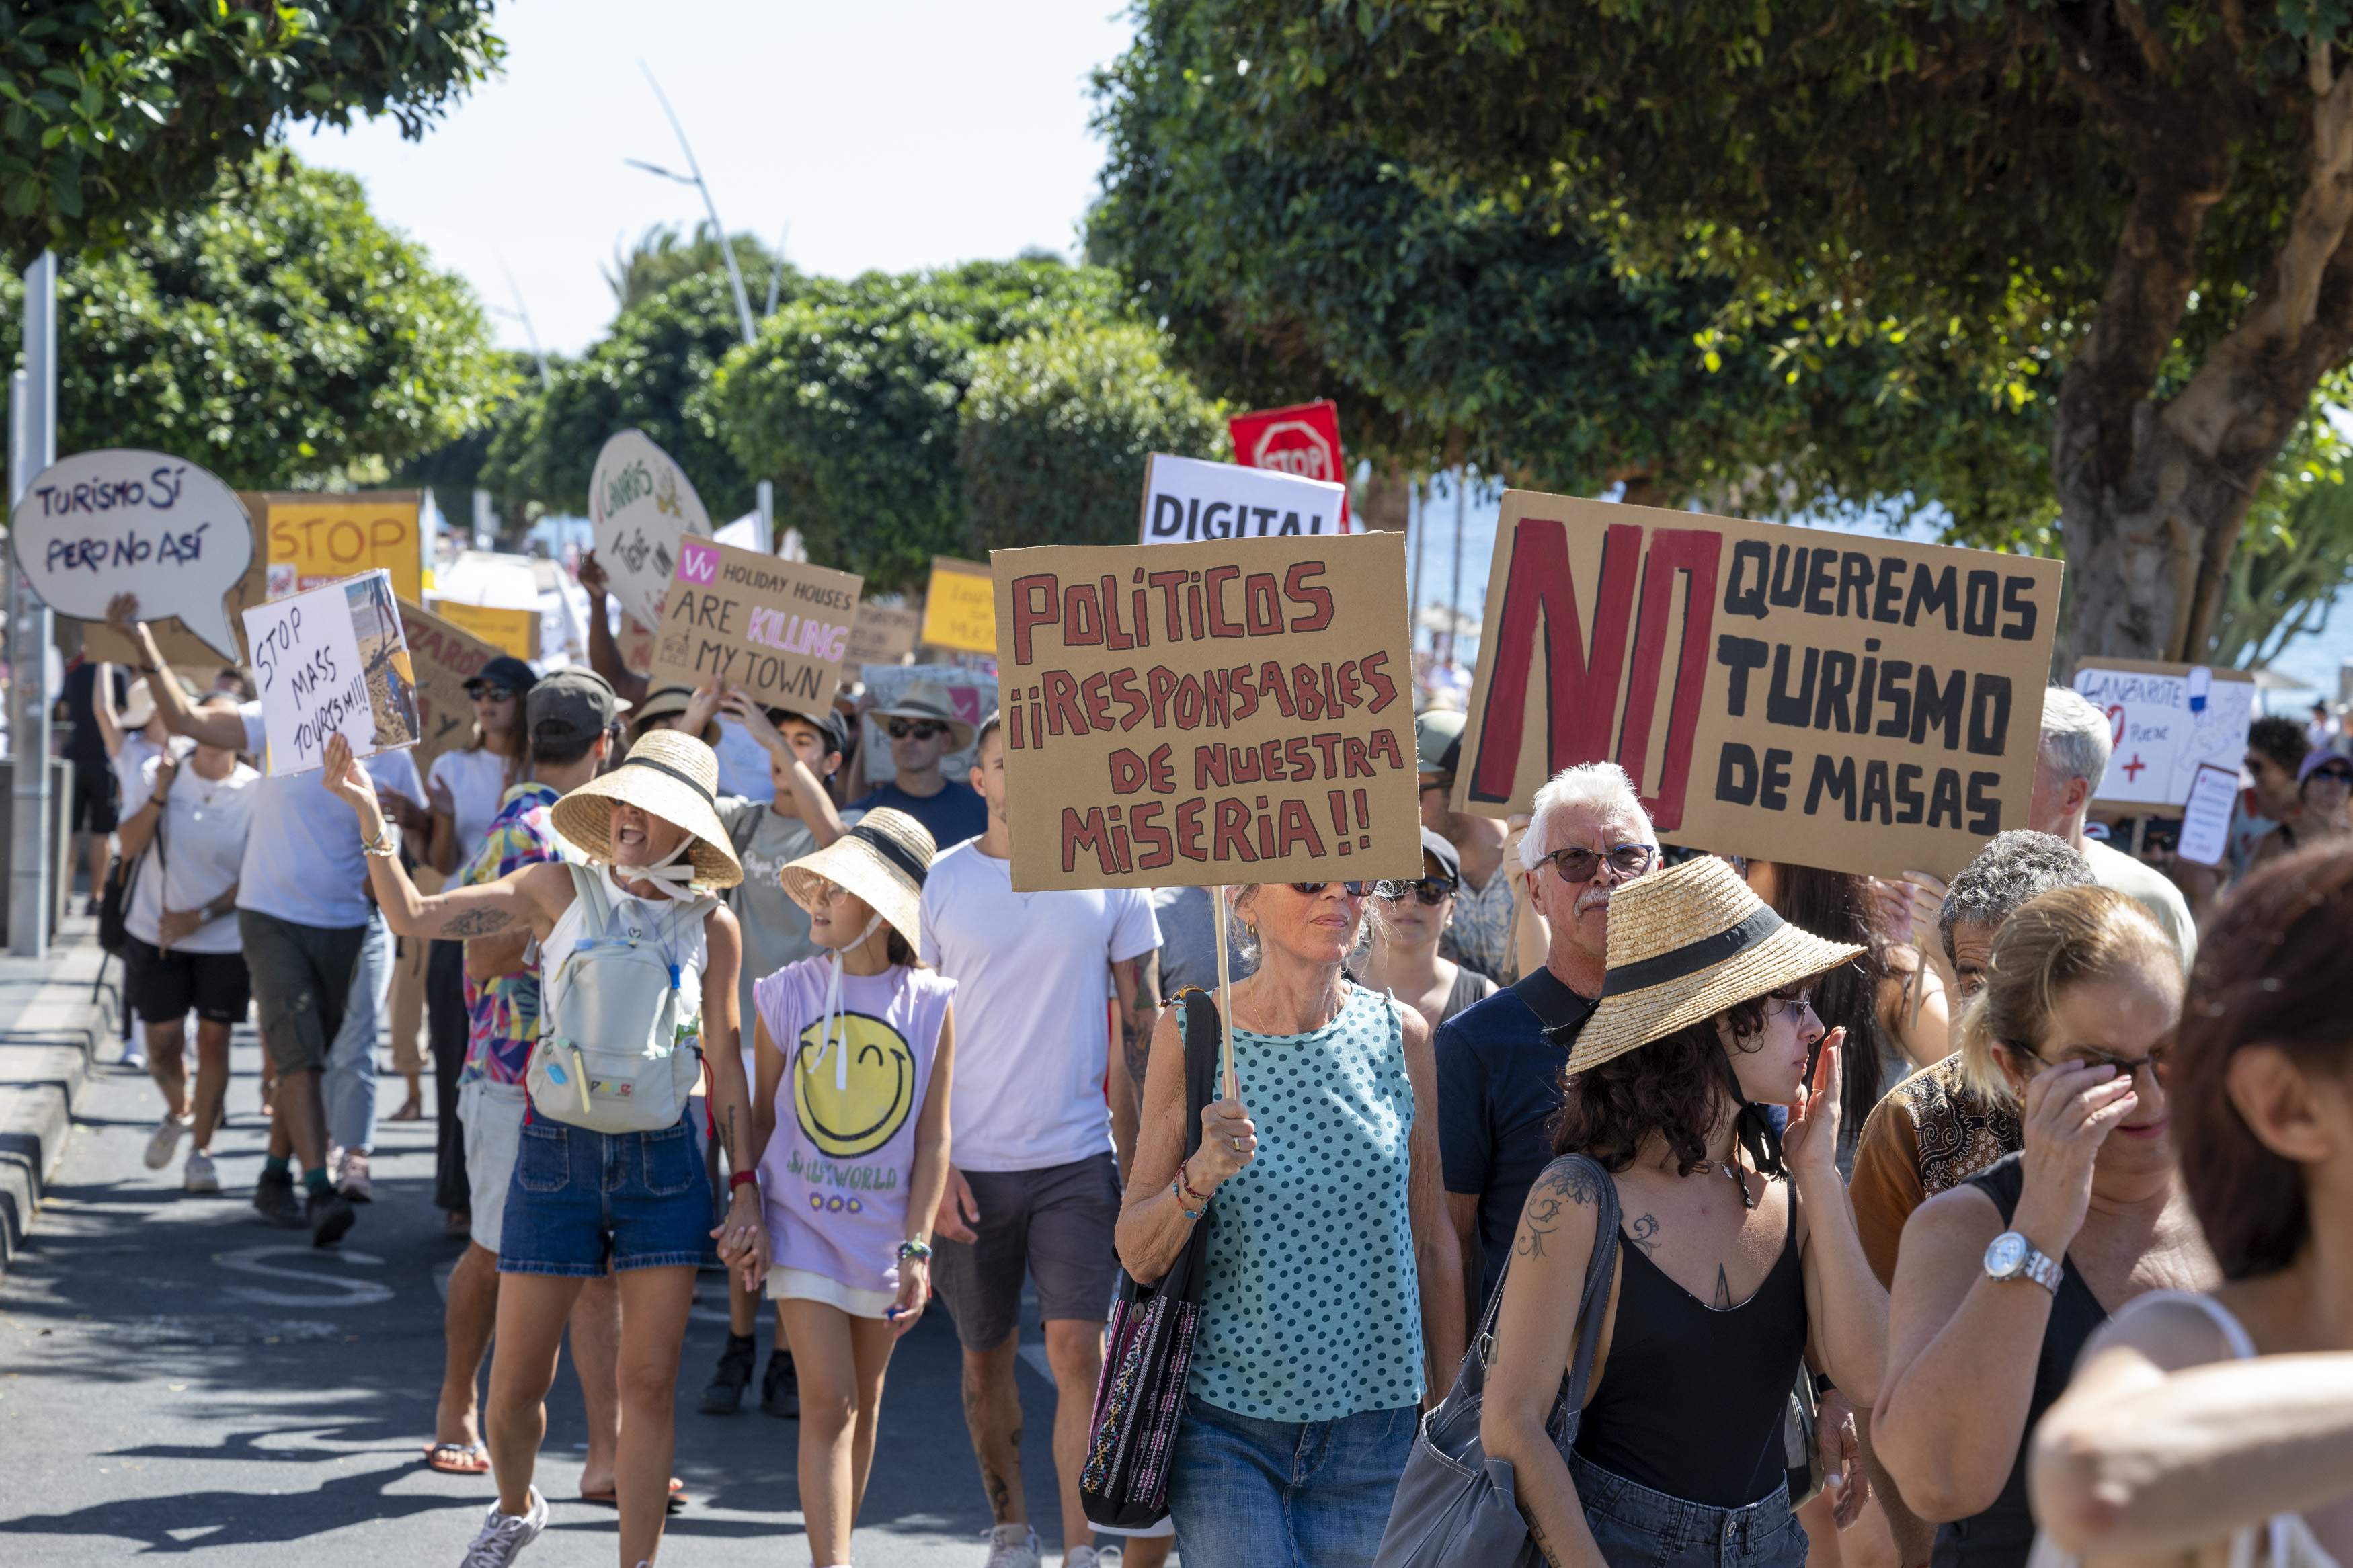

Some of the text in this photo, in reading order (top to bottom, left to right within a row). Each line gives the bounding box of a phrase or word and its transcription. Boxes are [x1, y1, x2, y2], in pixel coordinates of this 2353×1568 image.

[148, 466, 186, 509] SÍ
[46, 522, 210, 573] PERO NO ASÍ
[271, 518, 407, 567] STOP
[723, 563, 788, 593] HOLIDAY
[793, 582, 853, 611] HOUSES
[1724, 540, 2037, 641] QUEREMOS
[256, 606, 301, 694] STOP
[672, 590, 740, 635] ARE
[746, 606, 850, 663] KILLING
[292, 645, 336, 711] MASS
[694, 640, 738, 675] MY
[744, 651, 824, 701] TOWN
[1470, 518, 1722, 832] NO
[1109, 729, 1404, 795] DE NUESTRA
[1715, 742, 2001, 836] DE MASAS
[834, 1165, 897, 1190] WORLD
